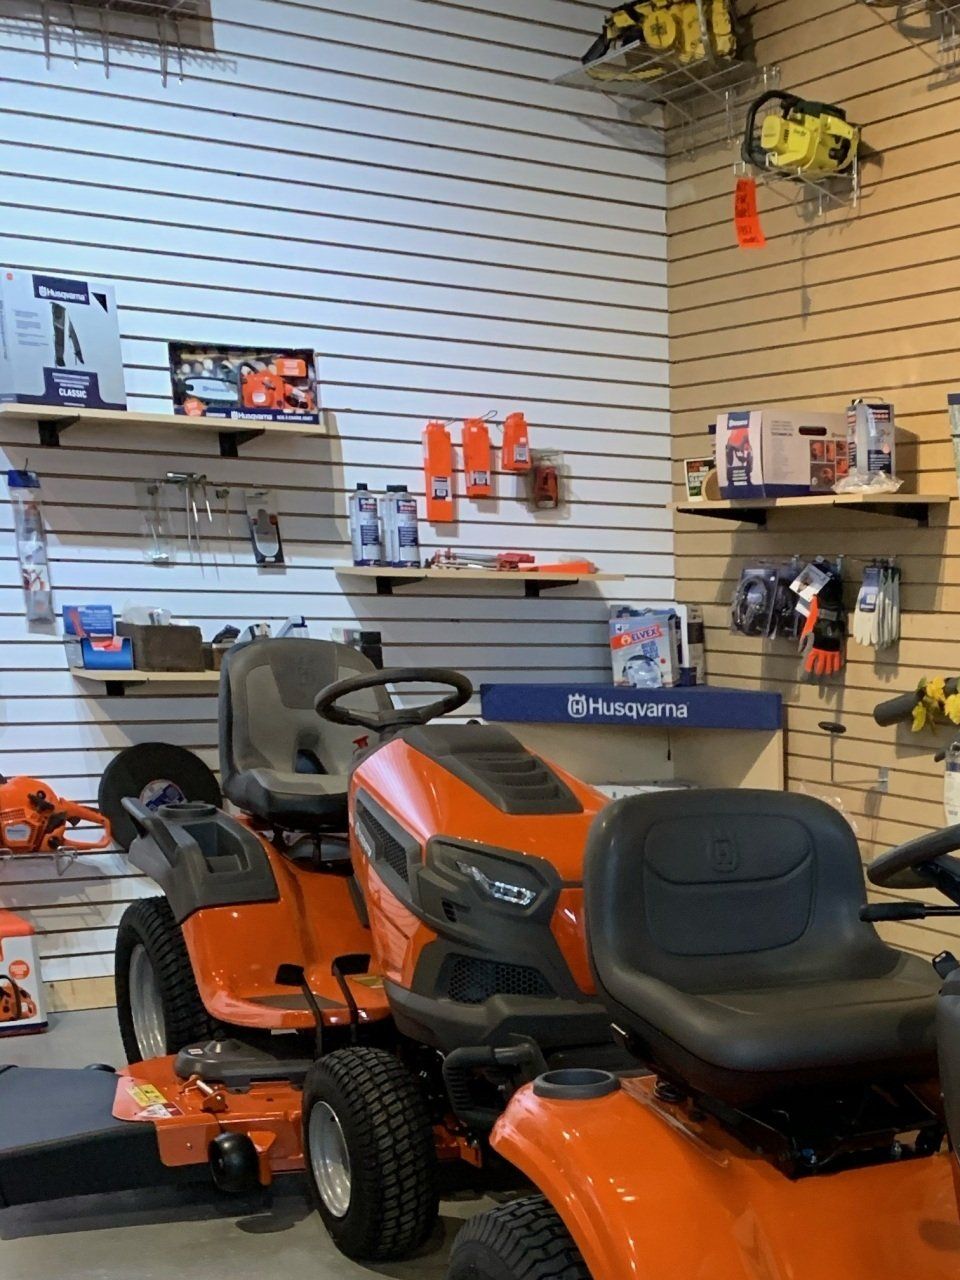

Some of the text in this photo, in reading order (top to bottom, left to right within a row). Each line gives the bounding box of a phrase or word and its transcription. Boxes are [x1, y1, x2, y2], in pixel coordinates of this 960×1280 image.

[47, 288, 86, 301] Husqvarna
[58, 388, 87, 399] CLASSIC
[631, 629, 658, 641] ELVEX
[589, 698, 688, 719] Husqvarna
